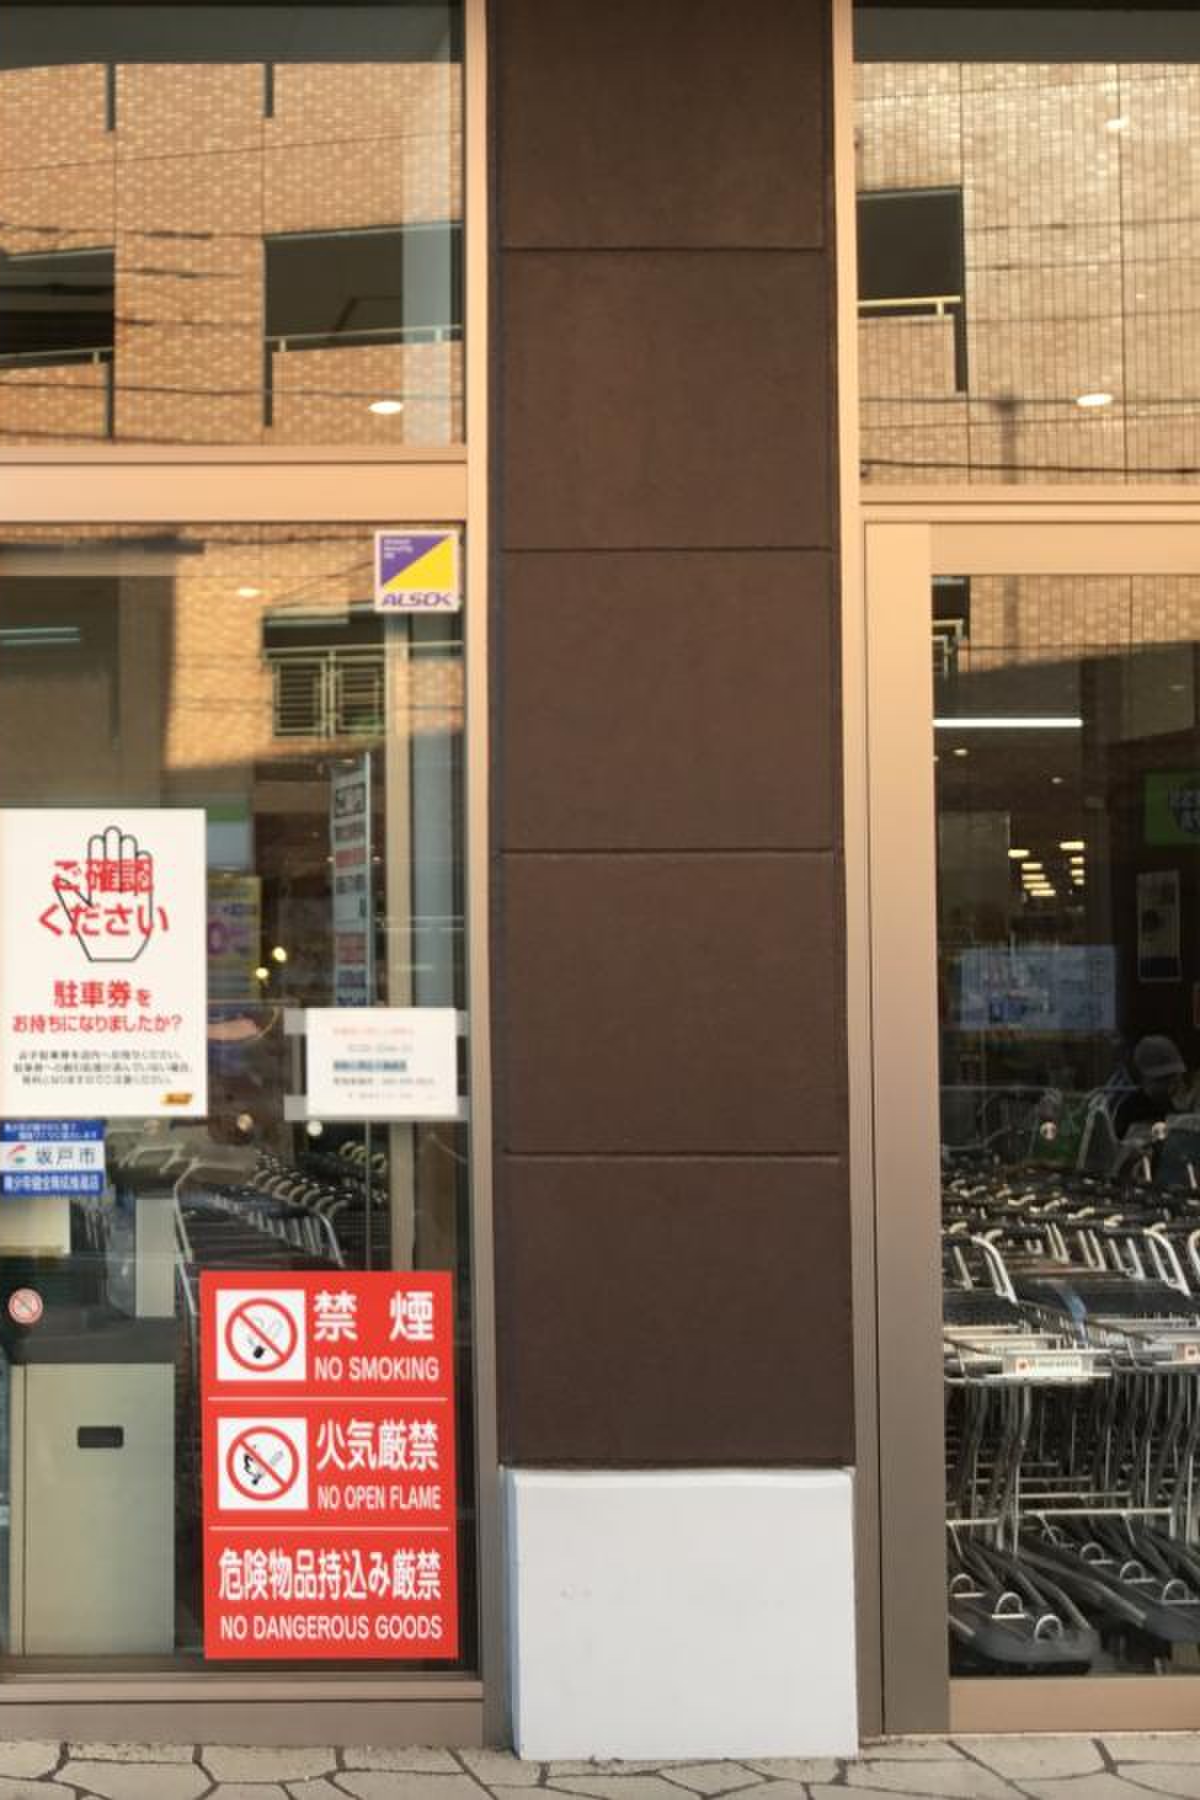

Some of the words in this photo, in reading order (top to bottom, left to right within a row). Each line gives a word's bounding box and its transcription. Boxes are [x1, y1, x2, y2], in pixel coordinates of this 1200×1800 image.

[52, 857, 154, 894] ご確認
[39, 903, 169, 938] ください
[53, 979, 151, 1009] 駐車券を
[313, 1290, 435, 1342] 禁煙
[314, 1355, 343, 1382] NO
[348, 1355, 440, 1382] SMOKING
[316, 1418, 439, 1472] 火気厳禁
[317, 1485, 341, 1510] NO
[344, 1485, 386, 1510] OPEN
[389, 1485, 441, 1510] FLAME
[218, 1547, 442, 1601] 危険物品持込み厳禁
[220, 1615, 248, 1640] NO
[253, 1615, 370, 1640] DANGEROUS
[374, 1615, 443, 1640] GOODS
